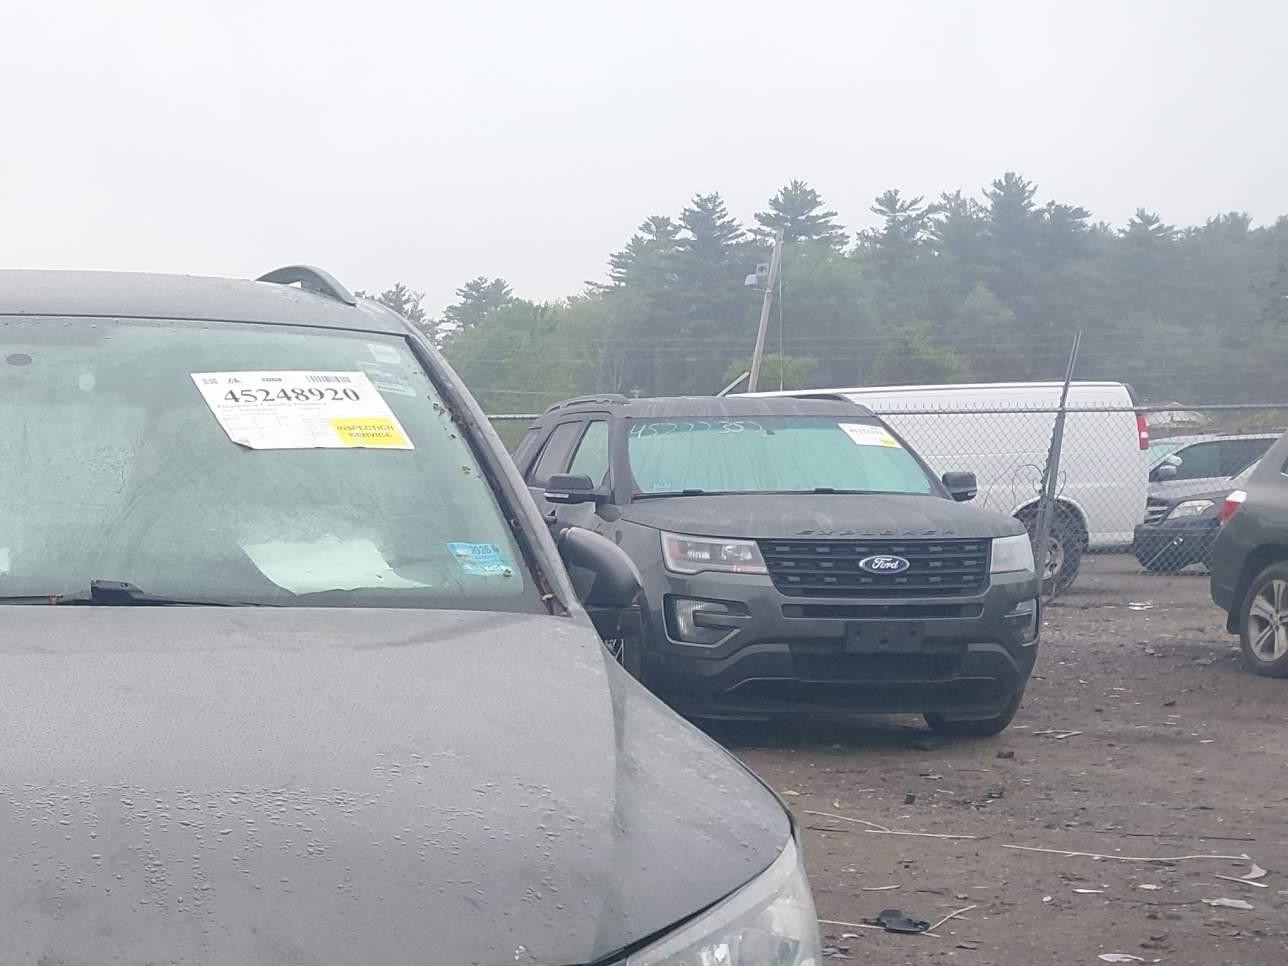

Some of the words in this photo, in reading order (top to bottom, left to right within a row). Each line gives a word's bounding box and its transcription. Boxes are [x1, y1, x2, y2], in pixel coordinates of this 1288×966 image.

[223, 387, 361, 404] 45248920
[336, 424, 395, 432] INSPECTION
[871, 557, 899, 570] Ford
